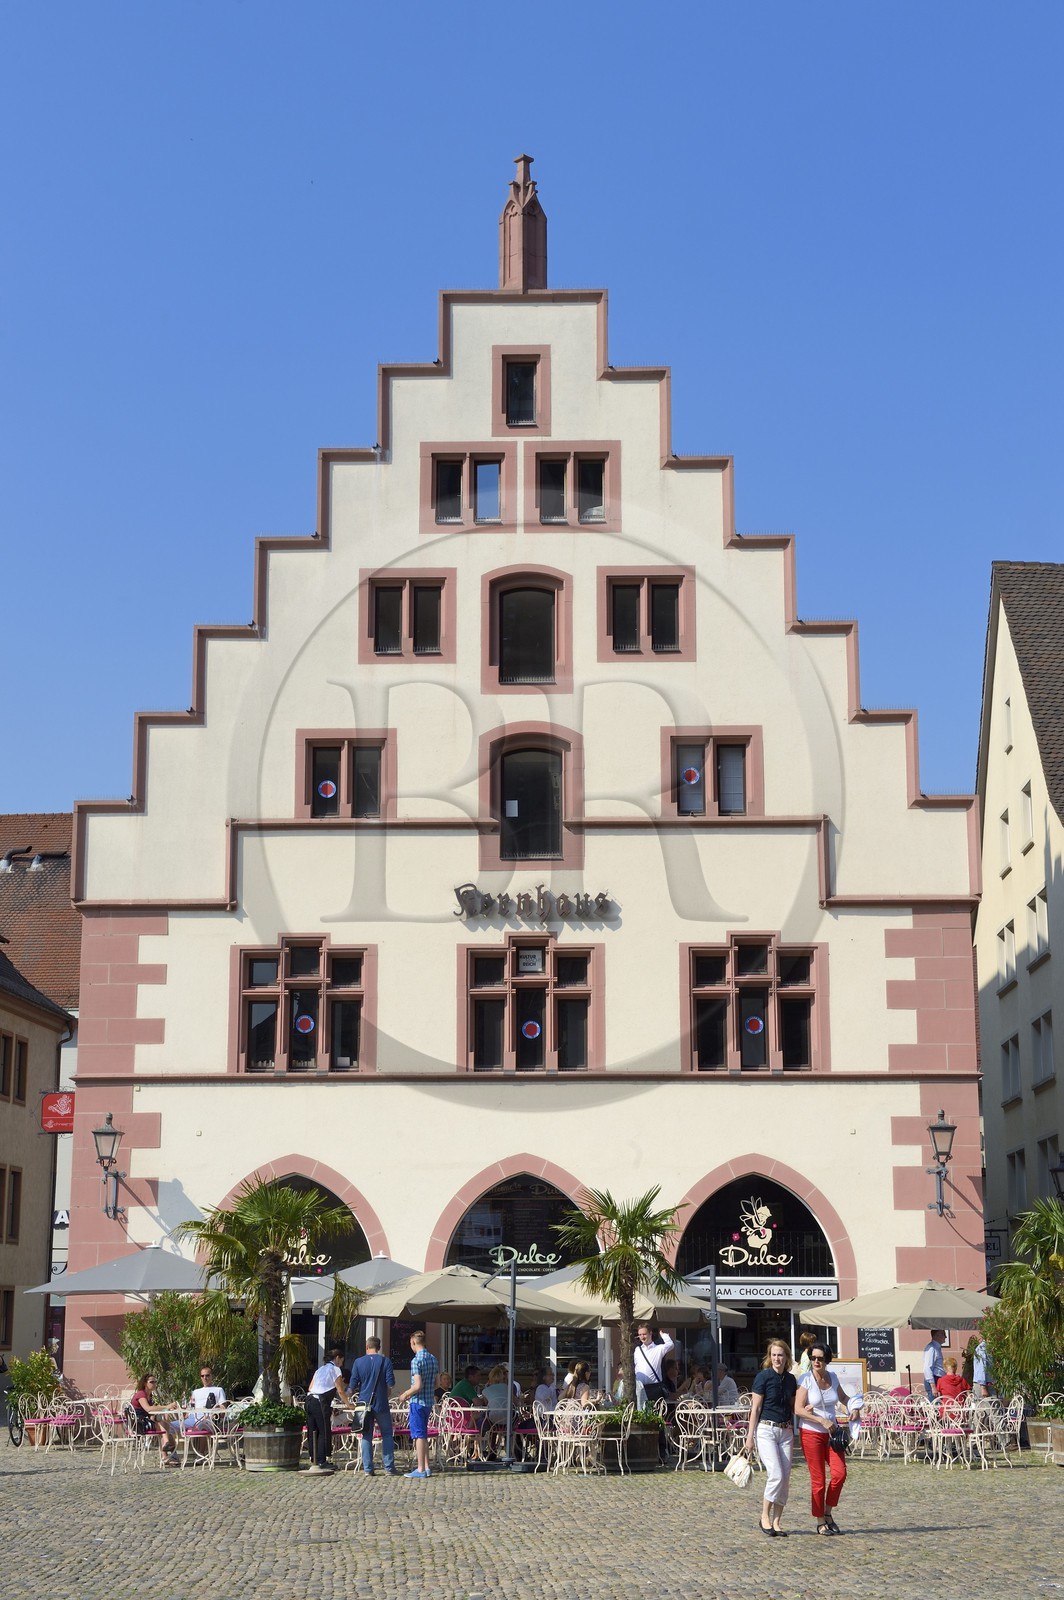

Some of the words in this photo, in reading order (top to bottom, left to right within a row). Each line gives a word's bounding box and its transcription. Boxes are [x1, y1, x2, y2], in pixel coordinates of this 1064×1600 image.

[452, 883, 610, 925] Kornhaus
[488, 1242, 562, 1266] Dulce
[718, 1244, 794, 1268] Dulce
[738, 1288, 793, 1296] CHOCOLATE
[799, 1288, 832, 1296] COFFEE
